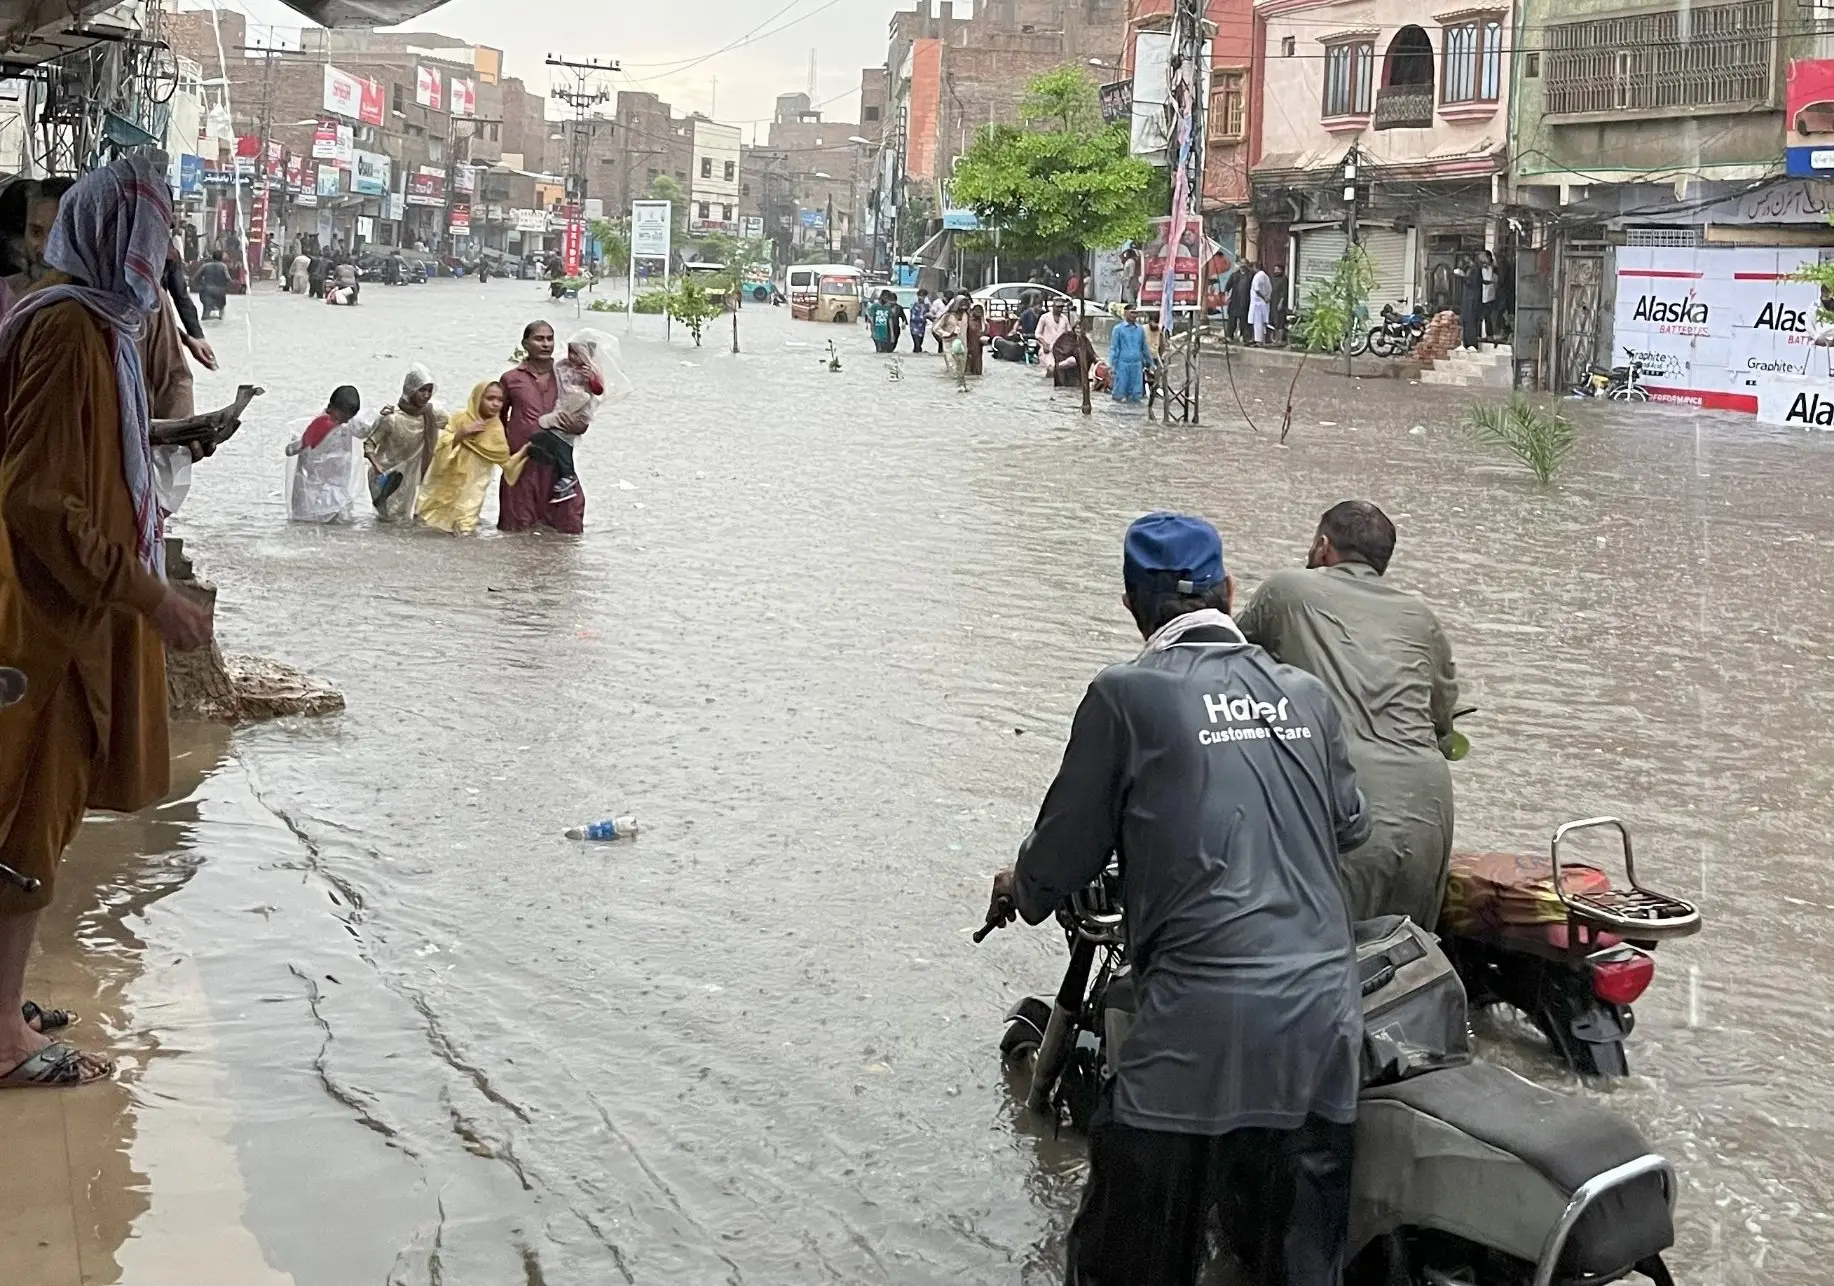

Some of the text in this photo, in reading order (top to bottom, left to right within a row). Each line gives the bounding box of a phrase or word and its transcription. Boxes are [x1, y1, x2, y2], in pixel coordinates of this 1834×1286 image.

[1633, 295, 1709, 323] Alaska
[1754, 302, 1807, 332] Alas
[1787, 336, 1813, 345] BATT
[1747, 357, 1793, 372] Graphite
[1785, 392, 1834, 426] Ala
[1198, 726, 1312, 745] Customer Care
